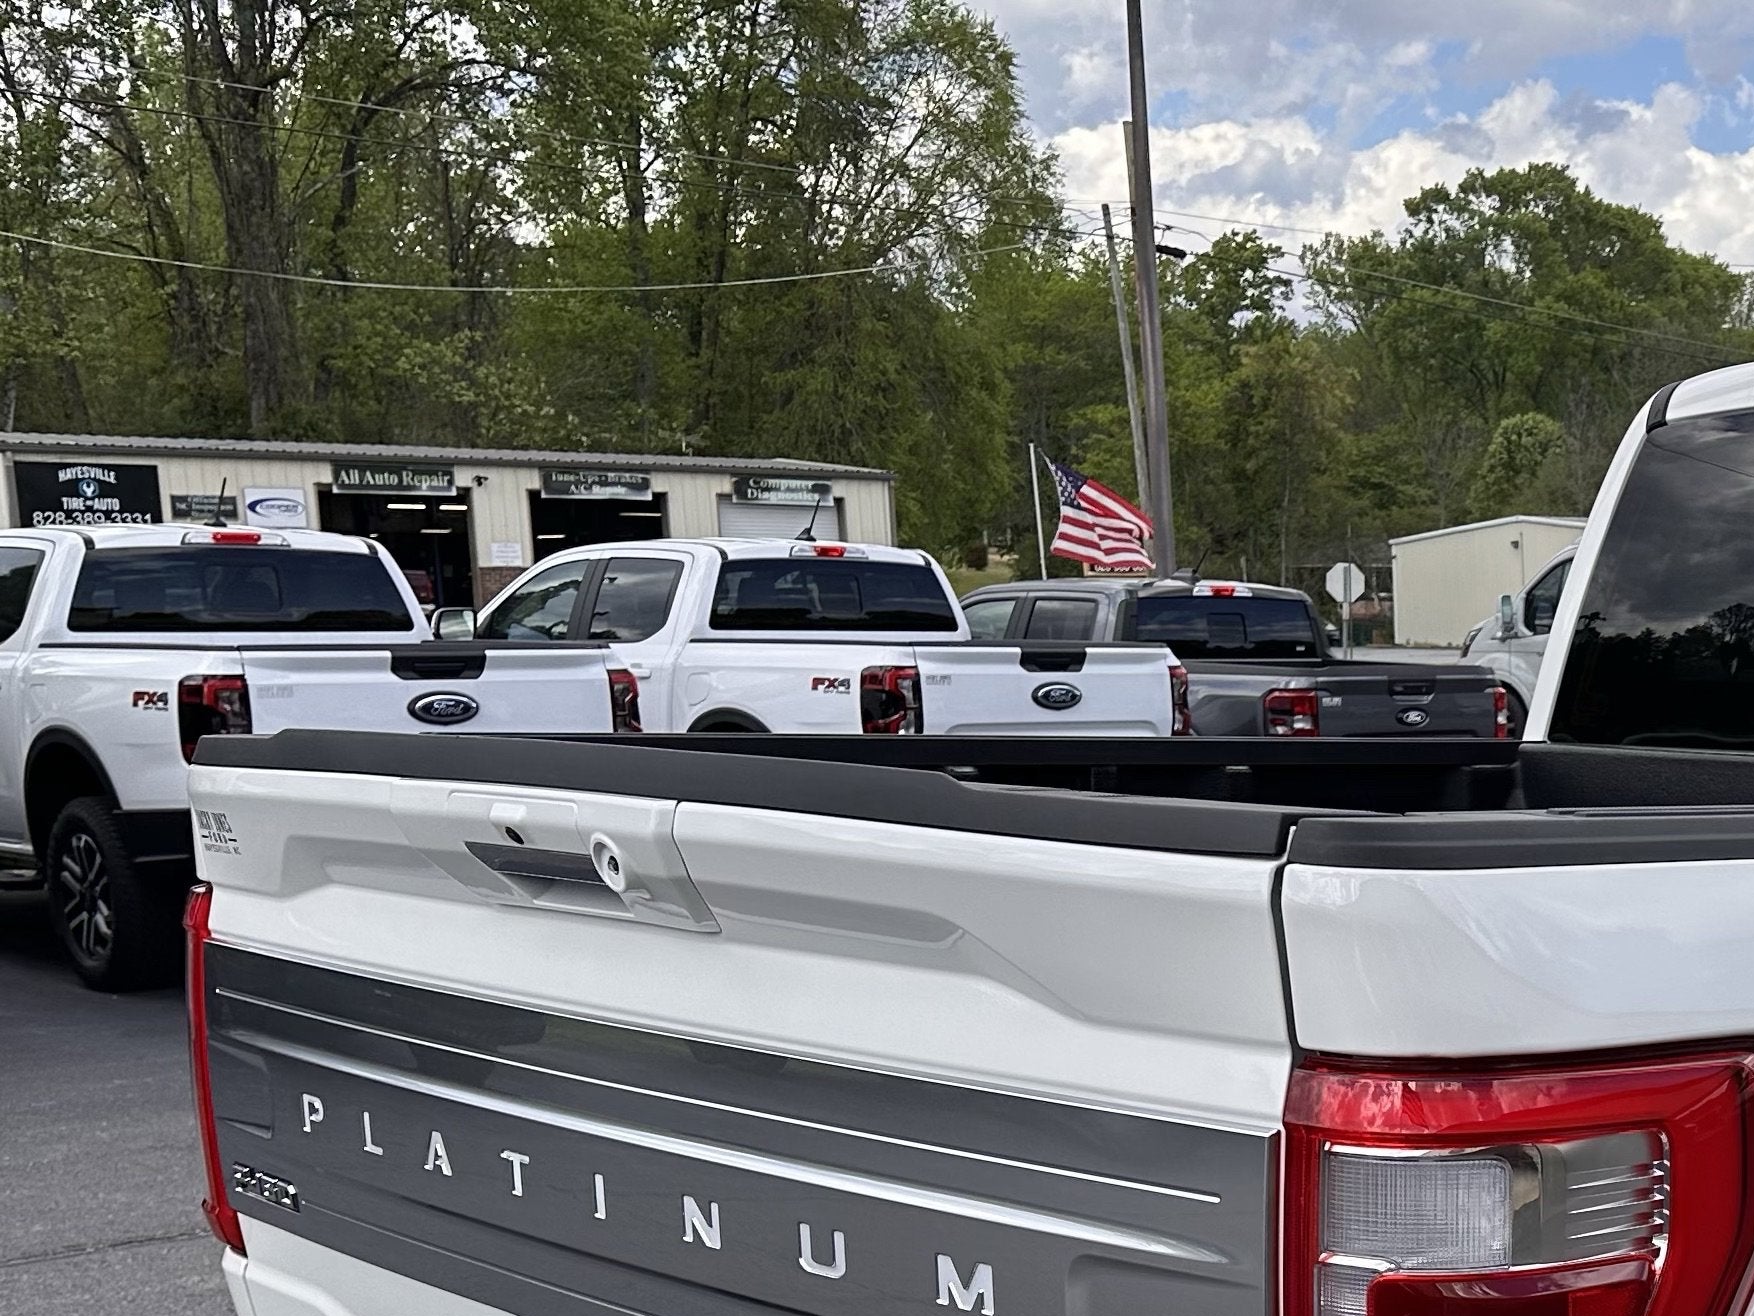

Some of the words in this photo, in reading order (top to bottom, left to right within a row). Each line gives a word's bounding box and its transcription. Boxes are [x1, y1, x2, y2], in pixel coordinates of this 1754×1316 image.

[58, 466, 117, 484] HAYESVILLE
[337, 469, 359, 485] All
[362, 470, 399, 486] Auto
[402, 470, 450, 490] Repair
[811, 677, 851, 691] FX4
[132, 692, 169, 707] FX4
[430, 700, 464, 716] Ford
[301, 1092, 995, 1316] PLATINUM
